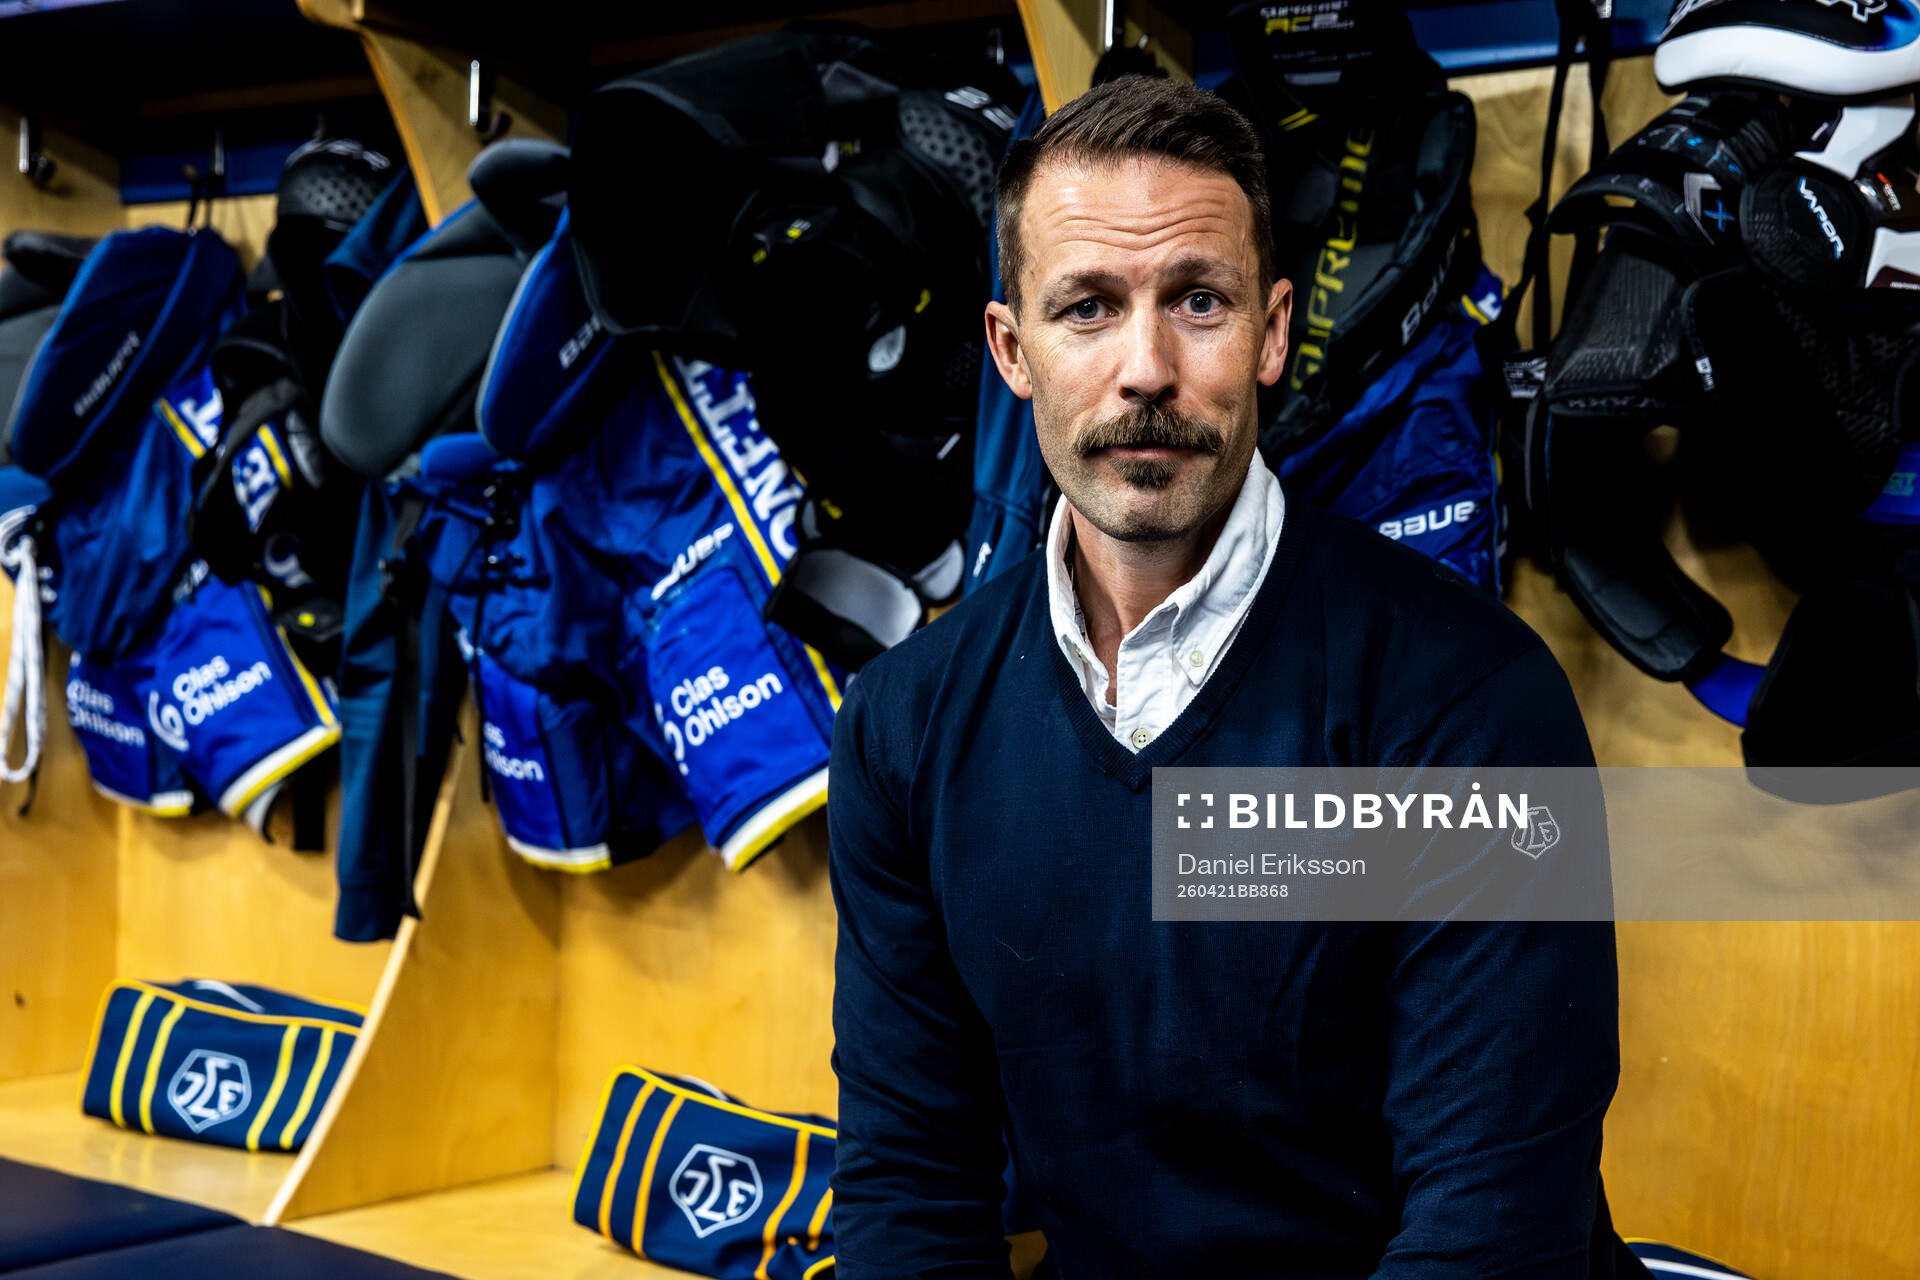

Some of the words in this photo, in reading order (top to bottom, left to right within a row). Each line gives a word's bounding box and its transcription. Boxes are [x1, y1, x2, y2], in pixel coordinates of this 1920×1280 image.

[1797, 175, 1845, 259] VAPOR
[172, 655, 230, 702] Clas
[182, 661, 273, 726] Ohlson
[670, 665, 730, 718] Clas
[684, 672, 784, 747] Ohlson
